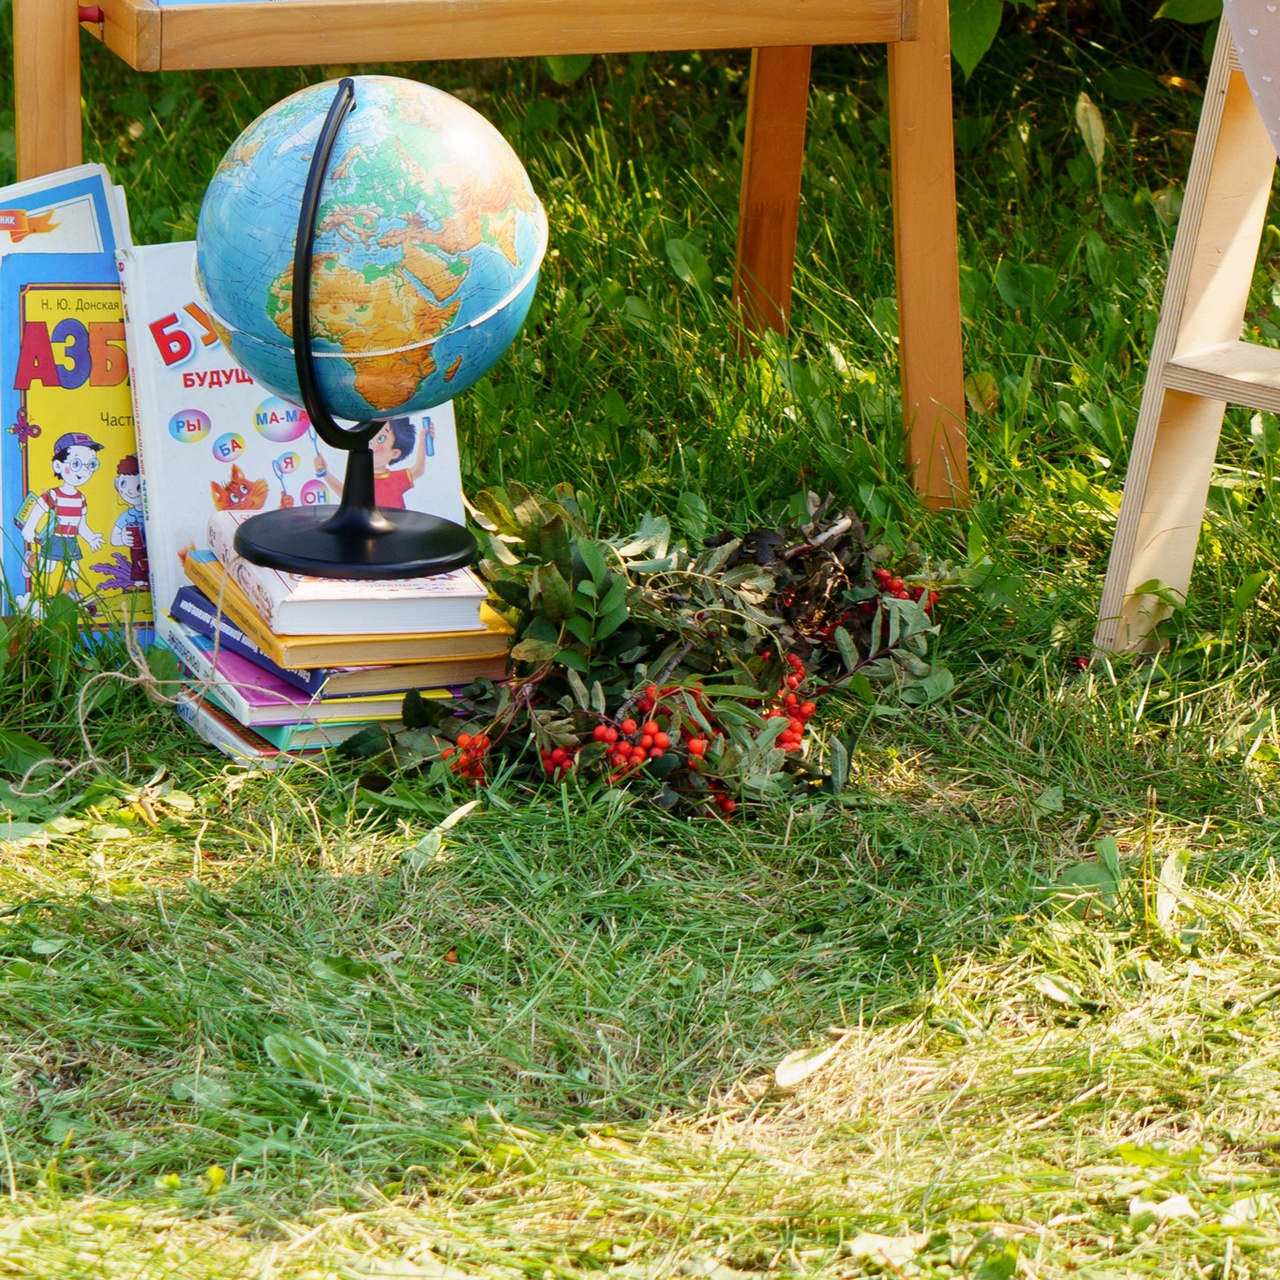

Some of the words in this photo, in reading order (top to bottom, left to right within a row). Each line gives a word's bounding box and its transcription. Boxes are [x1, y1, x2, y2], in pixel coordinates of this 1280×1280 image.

[41, 298, 52, 310] Н.
[57, 298, 71, 311] Ю.
[75, 298, 119, 312] Донская
[13, 318, 130, 391] АЗБ
[175, 417, 202, 433] РЫ
[218, 438, 242, 457] БА
[282, 456, 294, 469] Я
[304, 490, 327, 503] ОН
